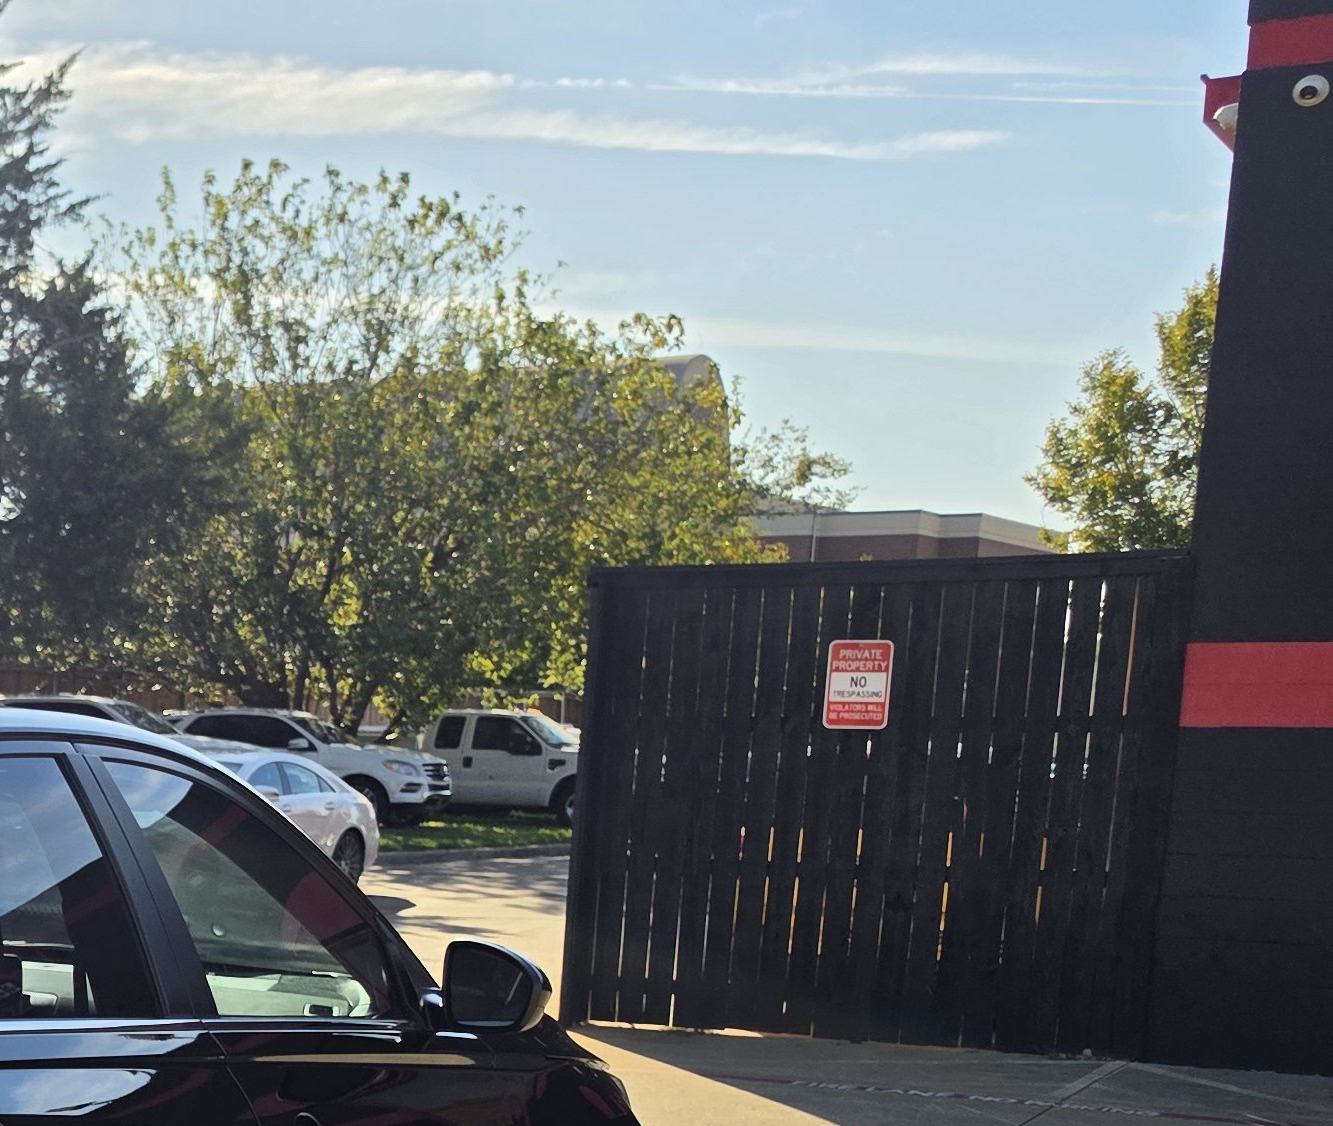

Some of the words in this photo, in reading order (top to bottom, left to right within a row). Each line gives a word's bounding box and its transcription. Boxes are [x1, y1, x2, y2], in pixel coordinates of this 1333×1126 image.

[839, 649, 883, 659] PRIVATE
[832, 661, 888, 671] PROPERTY
[850, 676, 867, 688] NO
[833, 690, 883, 699] TRESPASSING
